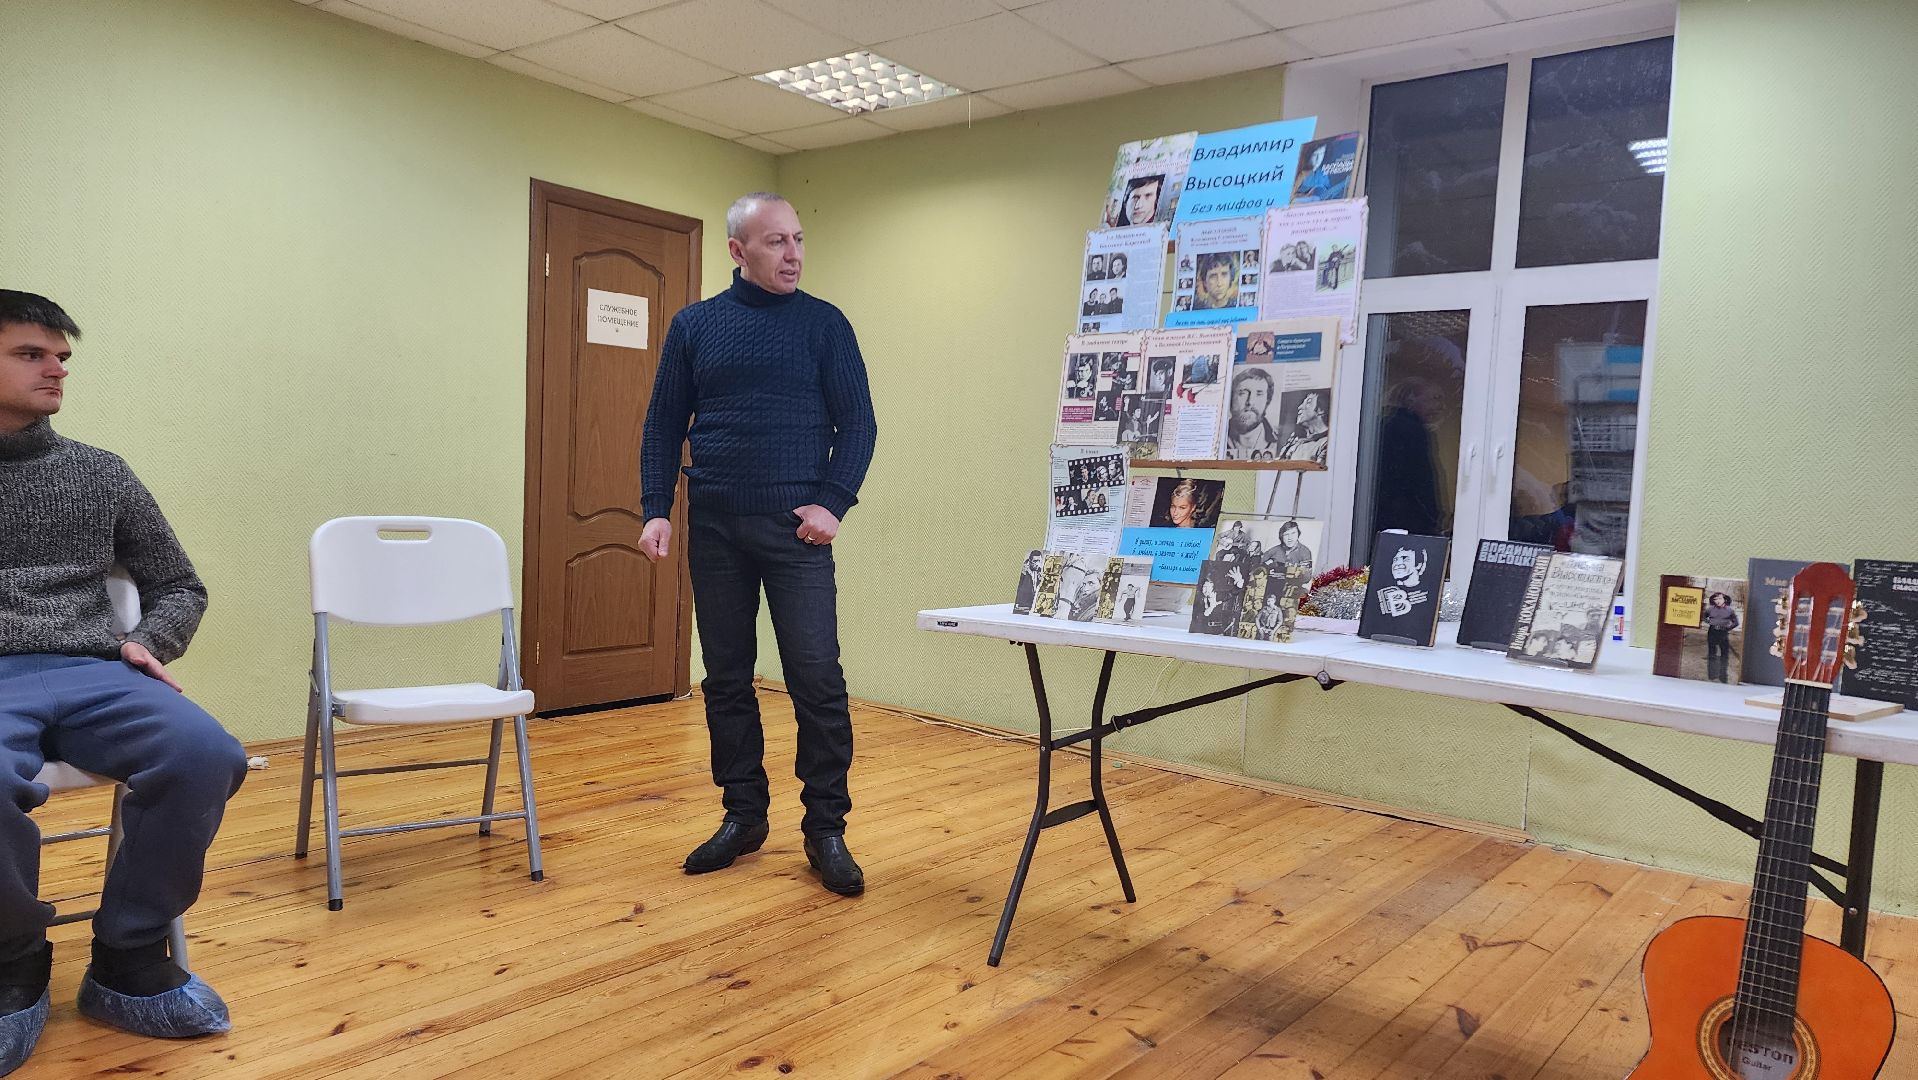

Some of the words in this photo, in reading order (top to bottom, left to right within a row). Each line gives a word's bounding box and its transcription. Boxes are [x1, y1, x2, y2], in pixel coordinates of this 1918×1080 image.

[1194, 138, 1294, 161] Владимир
[1185, 164, 1284, 191] Высоцкий
[1190, 203, 1212, 214] Без
[1216, 198, 1263, 212] мифов
[1267, 198, 1274, 206] и
[600, 304, 638, 316] СЛУЖЕБНОЕ
[598, 315, 639, 328] ПОМЕЩЕНИЕ
[1478, 550, 1536, 567] ВЫСОЦК
[1742, 1056, 1773, 1071] Guitar
